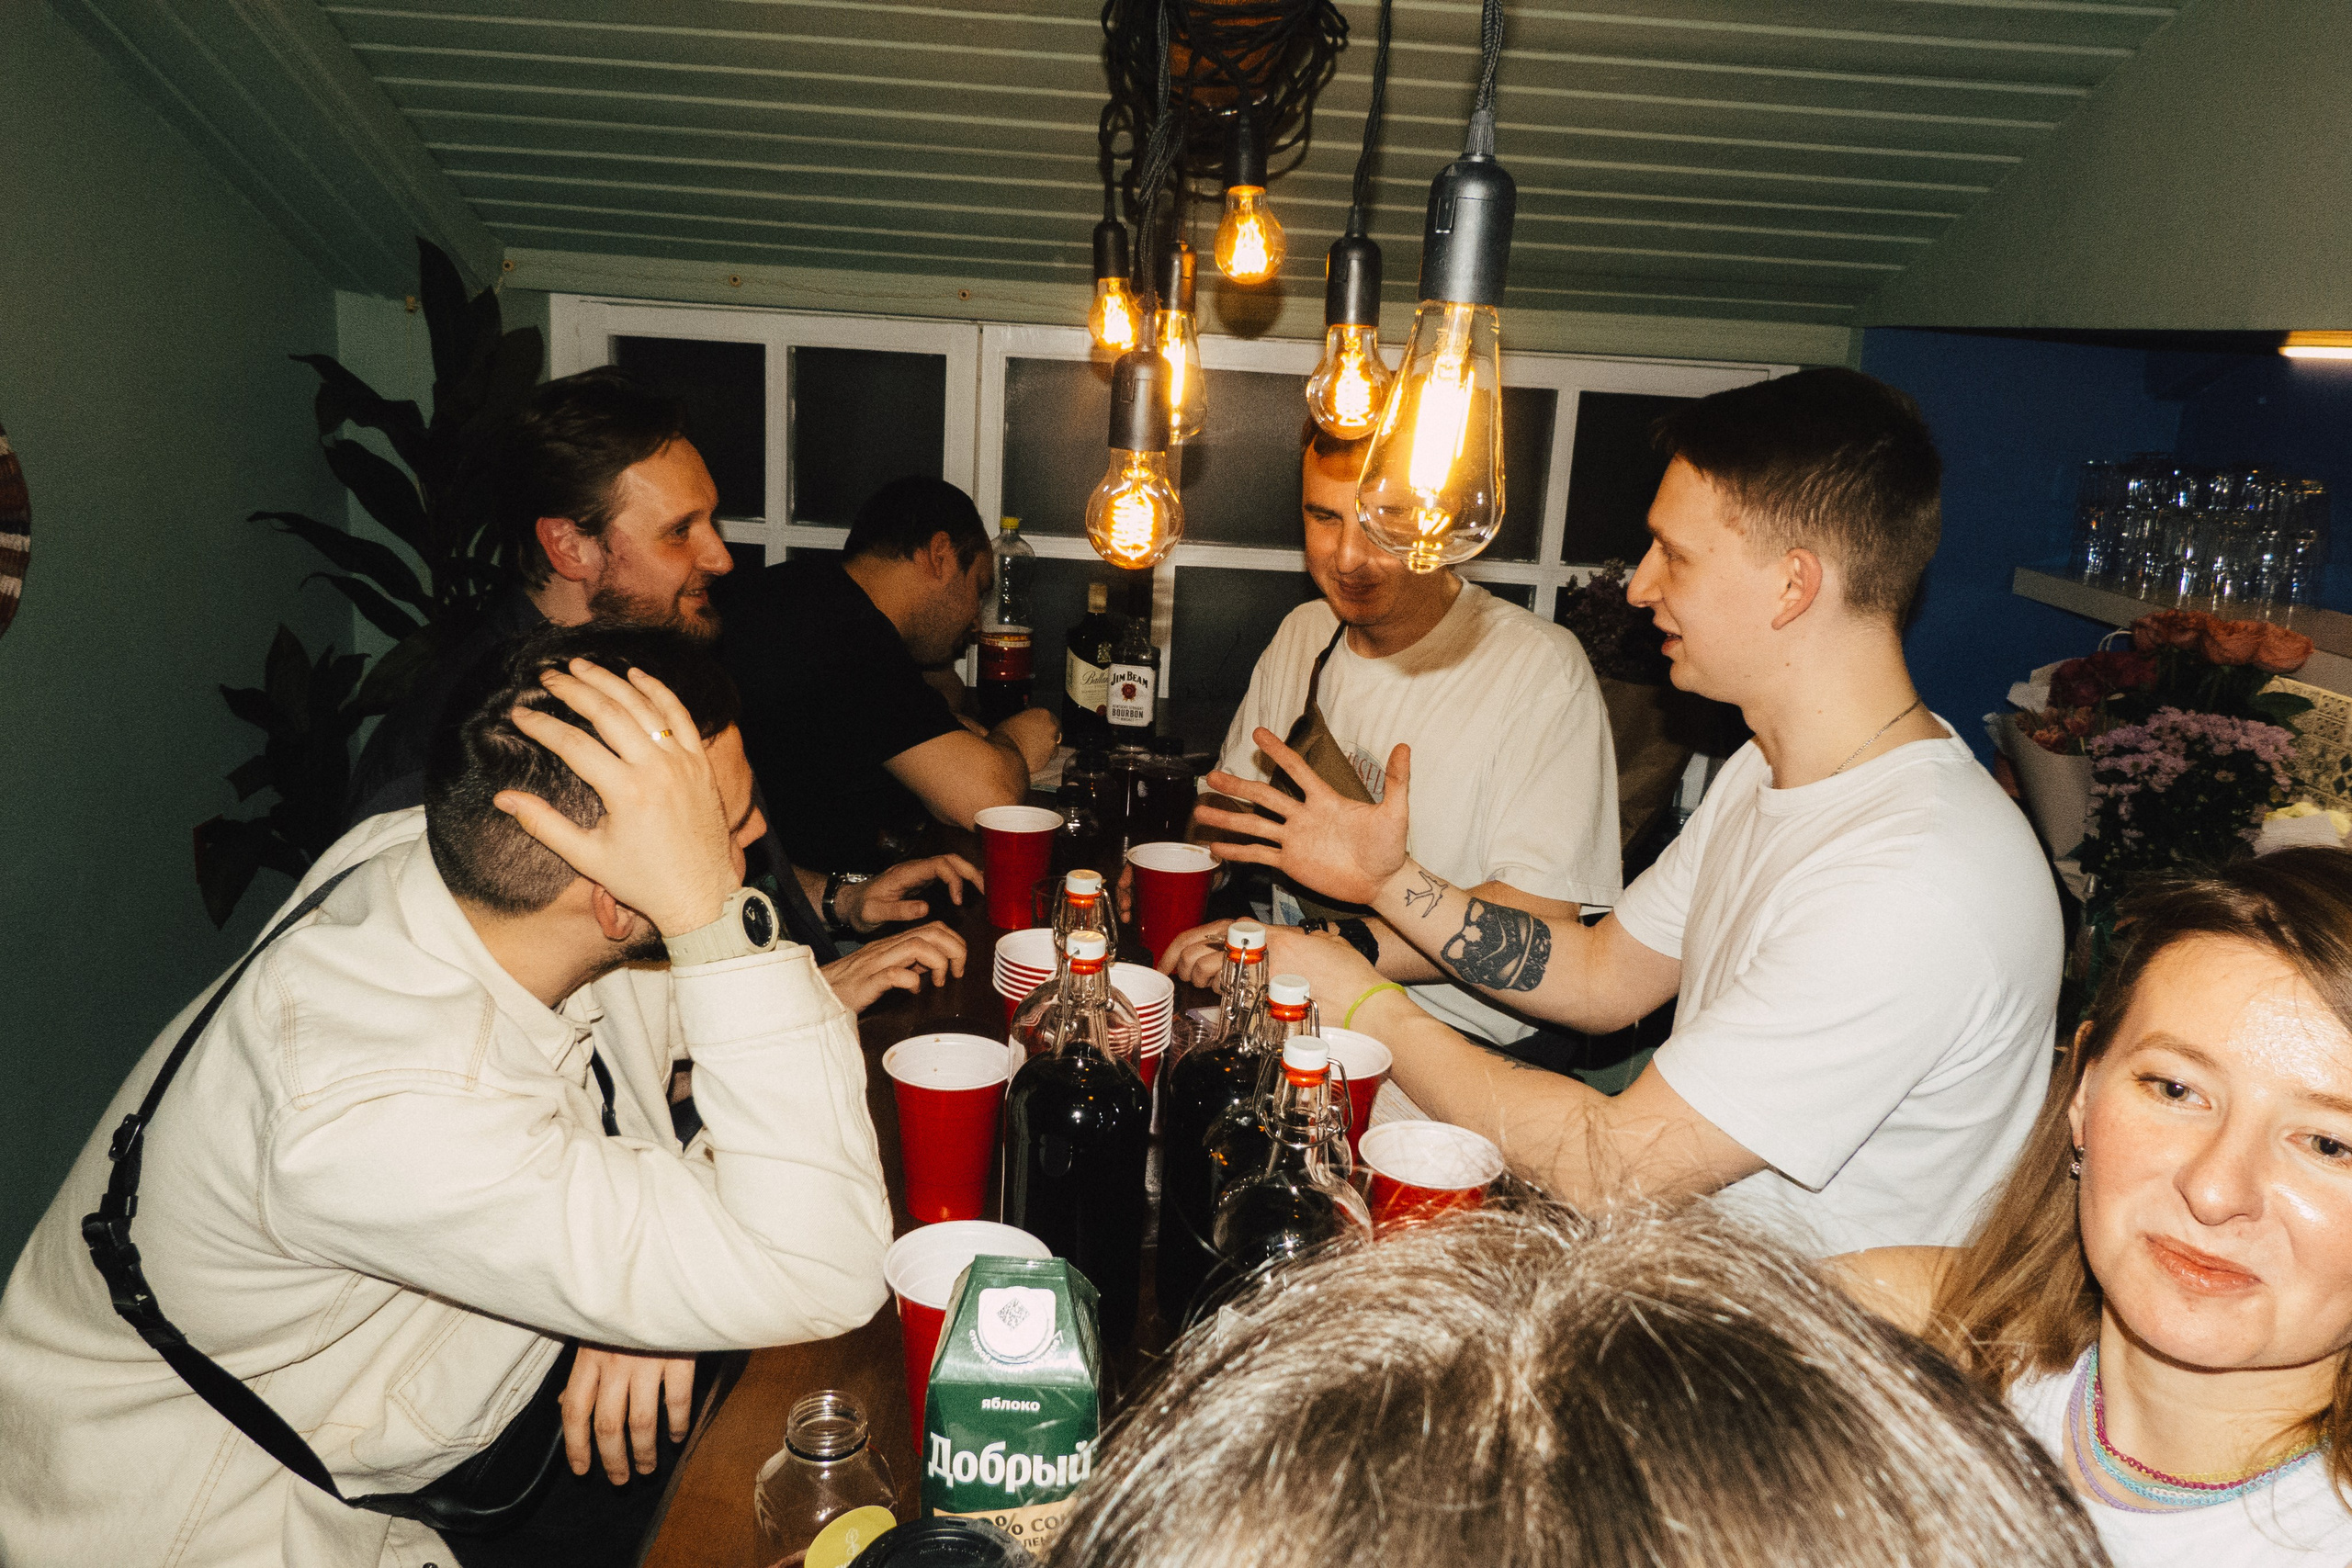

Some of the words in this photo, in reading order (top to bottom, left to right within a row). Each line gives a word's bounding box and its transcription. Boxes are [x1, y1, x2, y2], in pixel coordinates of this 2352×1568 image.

[1111, 672, 1125, 686] JIM
[1126, 671, 1148, 689] BEAM
[1112, 708, 1144, 718] BOURBON
[981, 1396, 1041, 1412] яблоко
[928, 1431, 1091, 1494] Добрый
